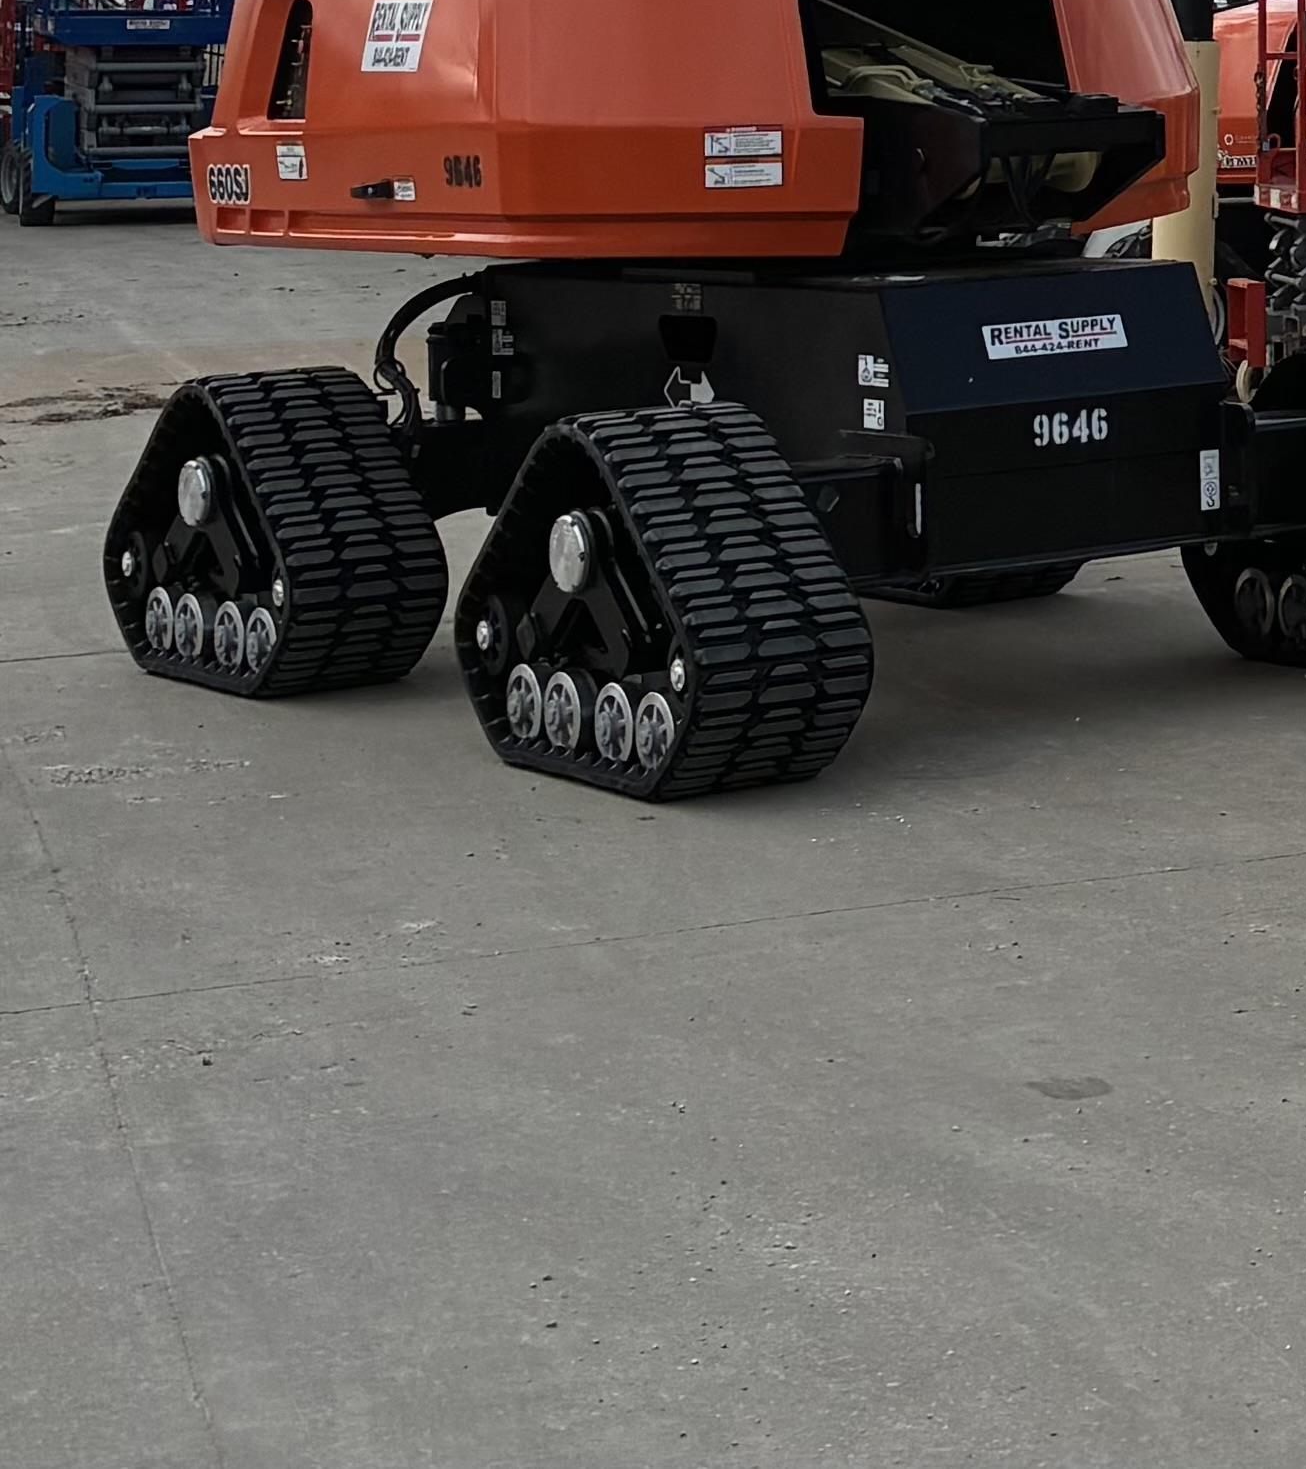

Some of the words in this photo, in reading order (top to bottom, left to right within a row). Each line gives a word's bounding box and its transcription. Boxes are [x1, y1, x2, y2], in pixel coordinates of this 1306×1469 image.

[990, 323, 1052, 346] RENTAL
[1058, 317, 1117, 339] SUPPLY
[1033, 408, 1109, 447] 9646
